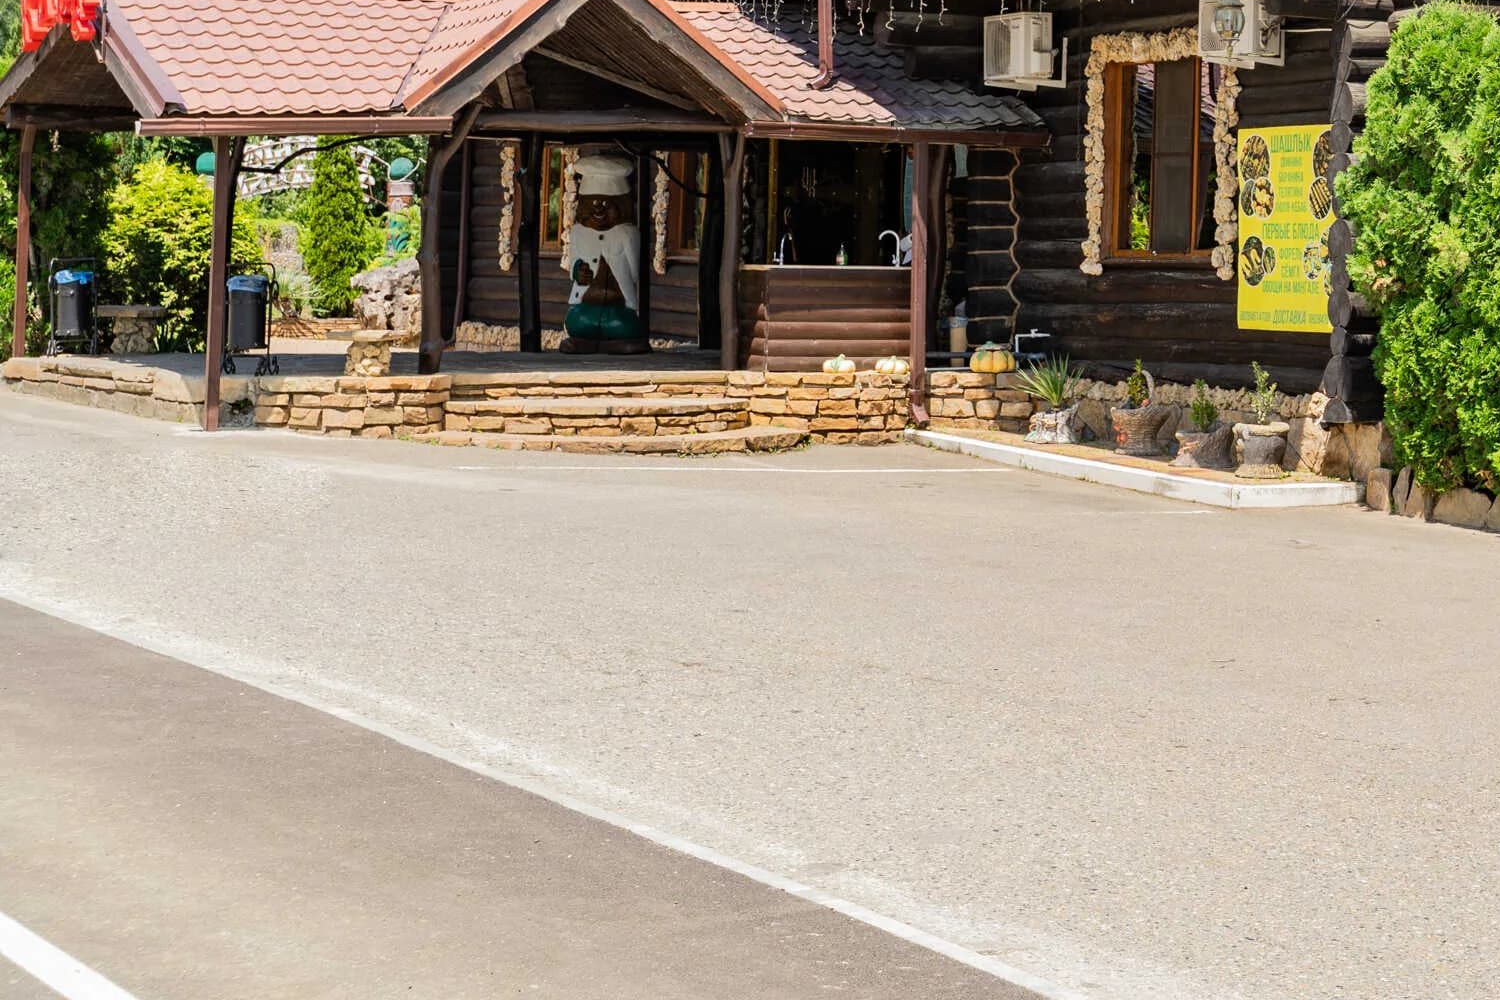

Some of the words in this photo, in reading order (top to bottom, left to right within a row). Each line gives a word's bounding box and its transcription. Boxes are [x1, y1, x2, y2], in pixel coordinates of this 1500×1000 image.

[1270, 132, 1312, 153] ШАШЛЫК
[1262, 222, 1290, 240] ПЕРВЫЕ
[1292, 222, 1320, 240] БЛЮДА
[1272, 309, 1306, 325] ДОСТАВКА
